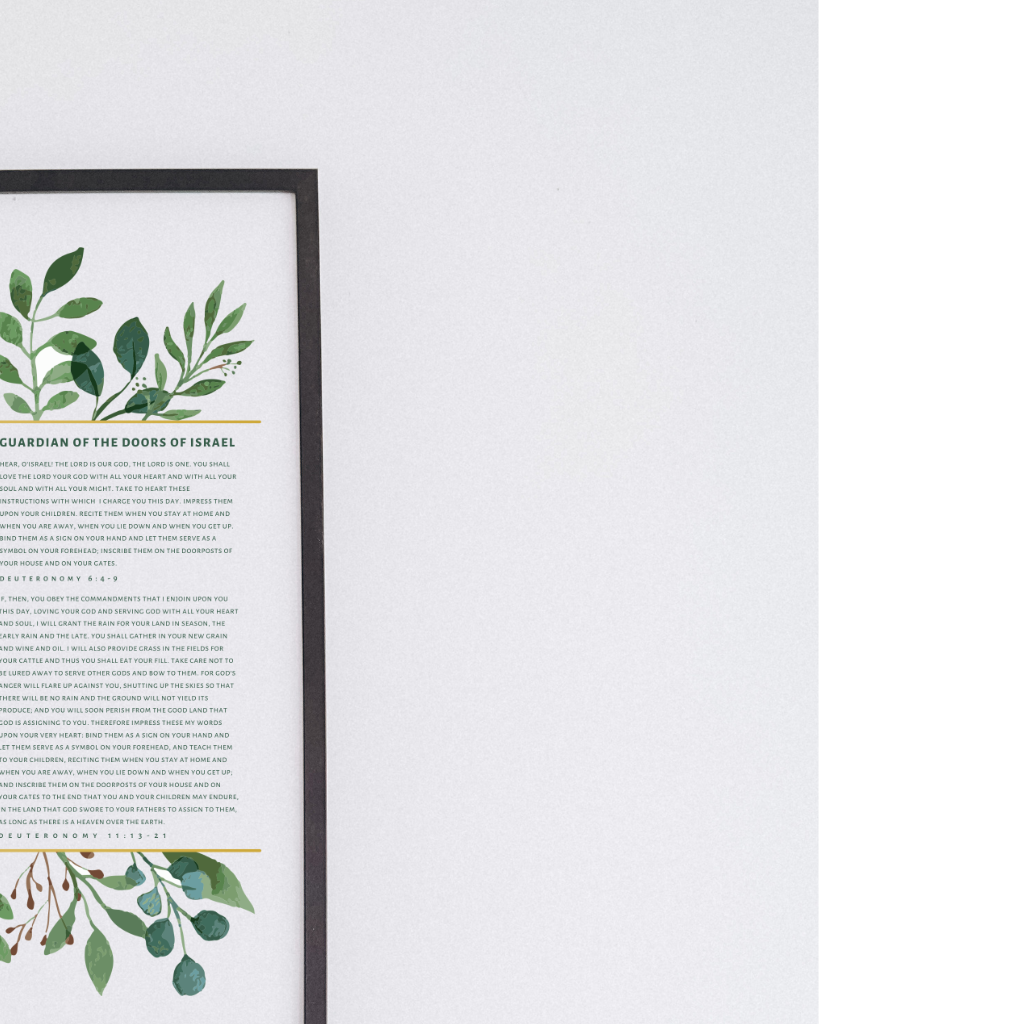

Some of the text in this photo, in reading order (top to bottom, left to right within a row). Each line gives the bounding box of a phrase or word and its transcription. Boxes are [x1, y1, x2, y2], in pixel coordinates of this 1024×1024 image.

[72, 438, 89, 448] OF
[92, 438, 118, 448] THE
[121, 438, 166, 448] DOORS
[170, 438, 186, 448] OF
[190, 438, 236, 448] ISRAEL
